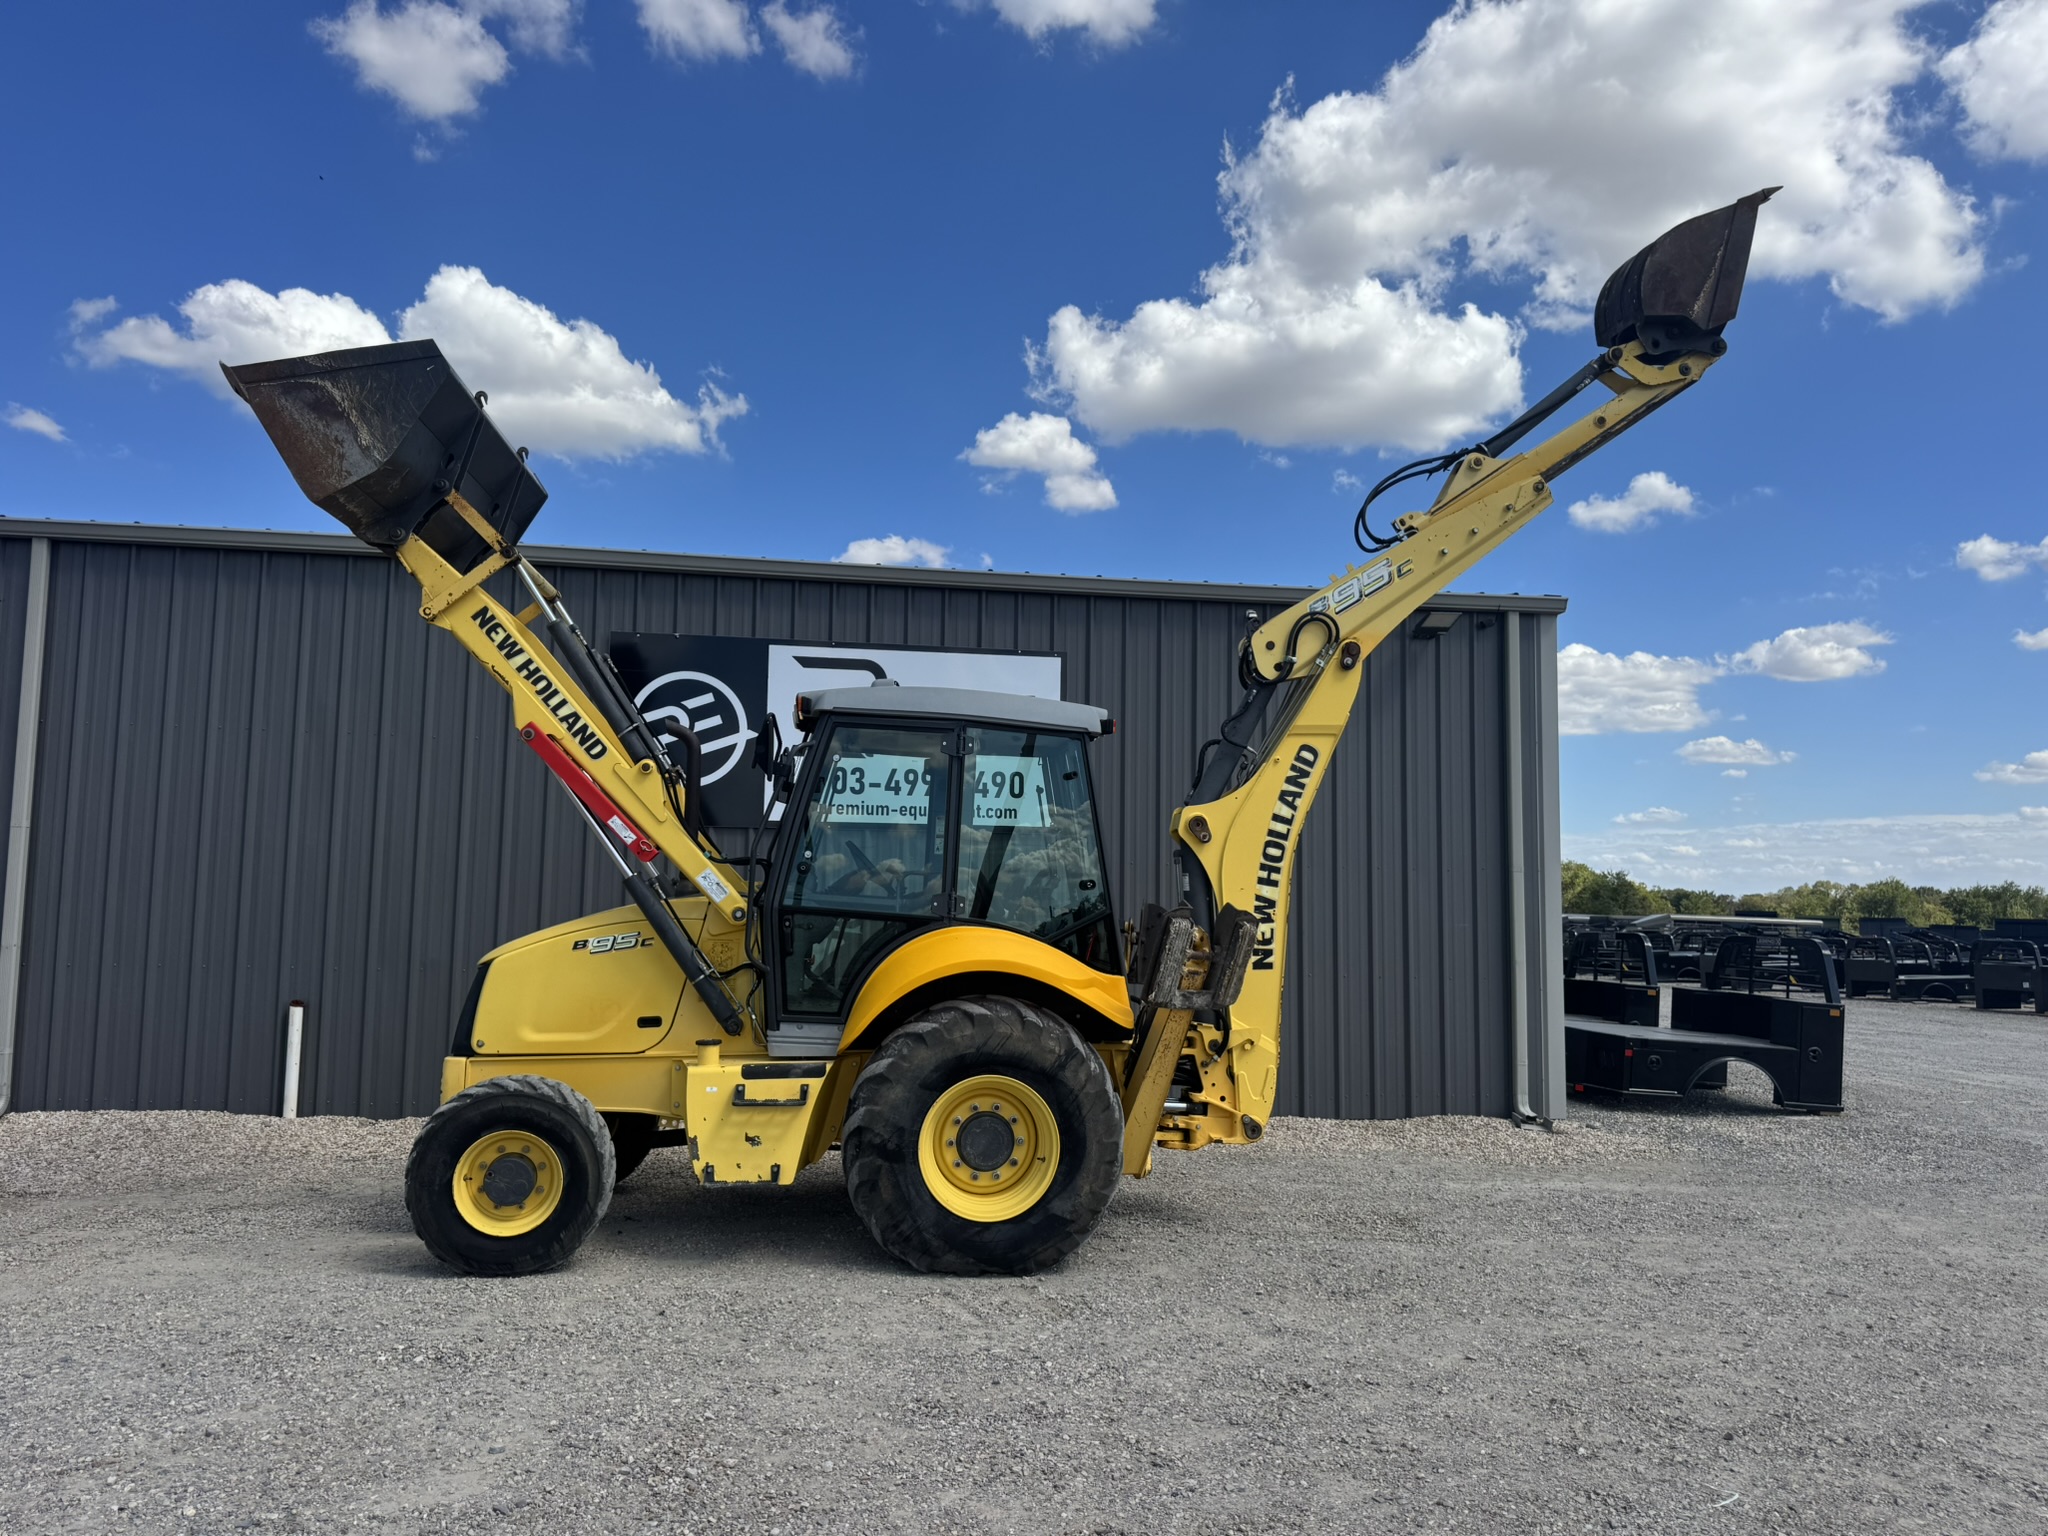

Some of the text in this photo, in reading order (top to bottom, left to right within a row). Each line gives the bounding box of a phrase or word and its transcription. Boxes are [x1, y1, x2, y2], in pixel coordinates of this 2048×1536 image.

[470, 604, 608, 760] NEW HOLLAND
[1251, 743, 1319, 971] NEW HOLLAND
